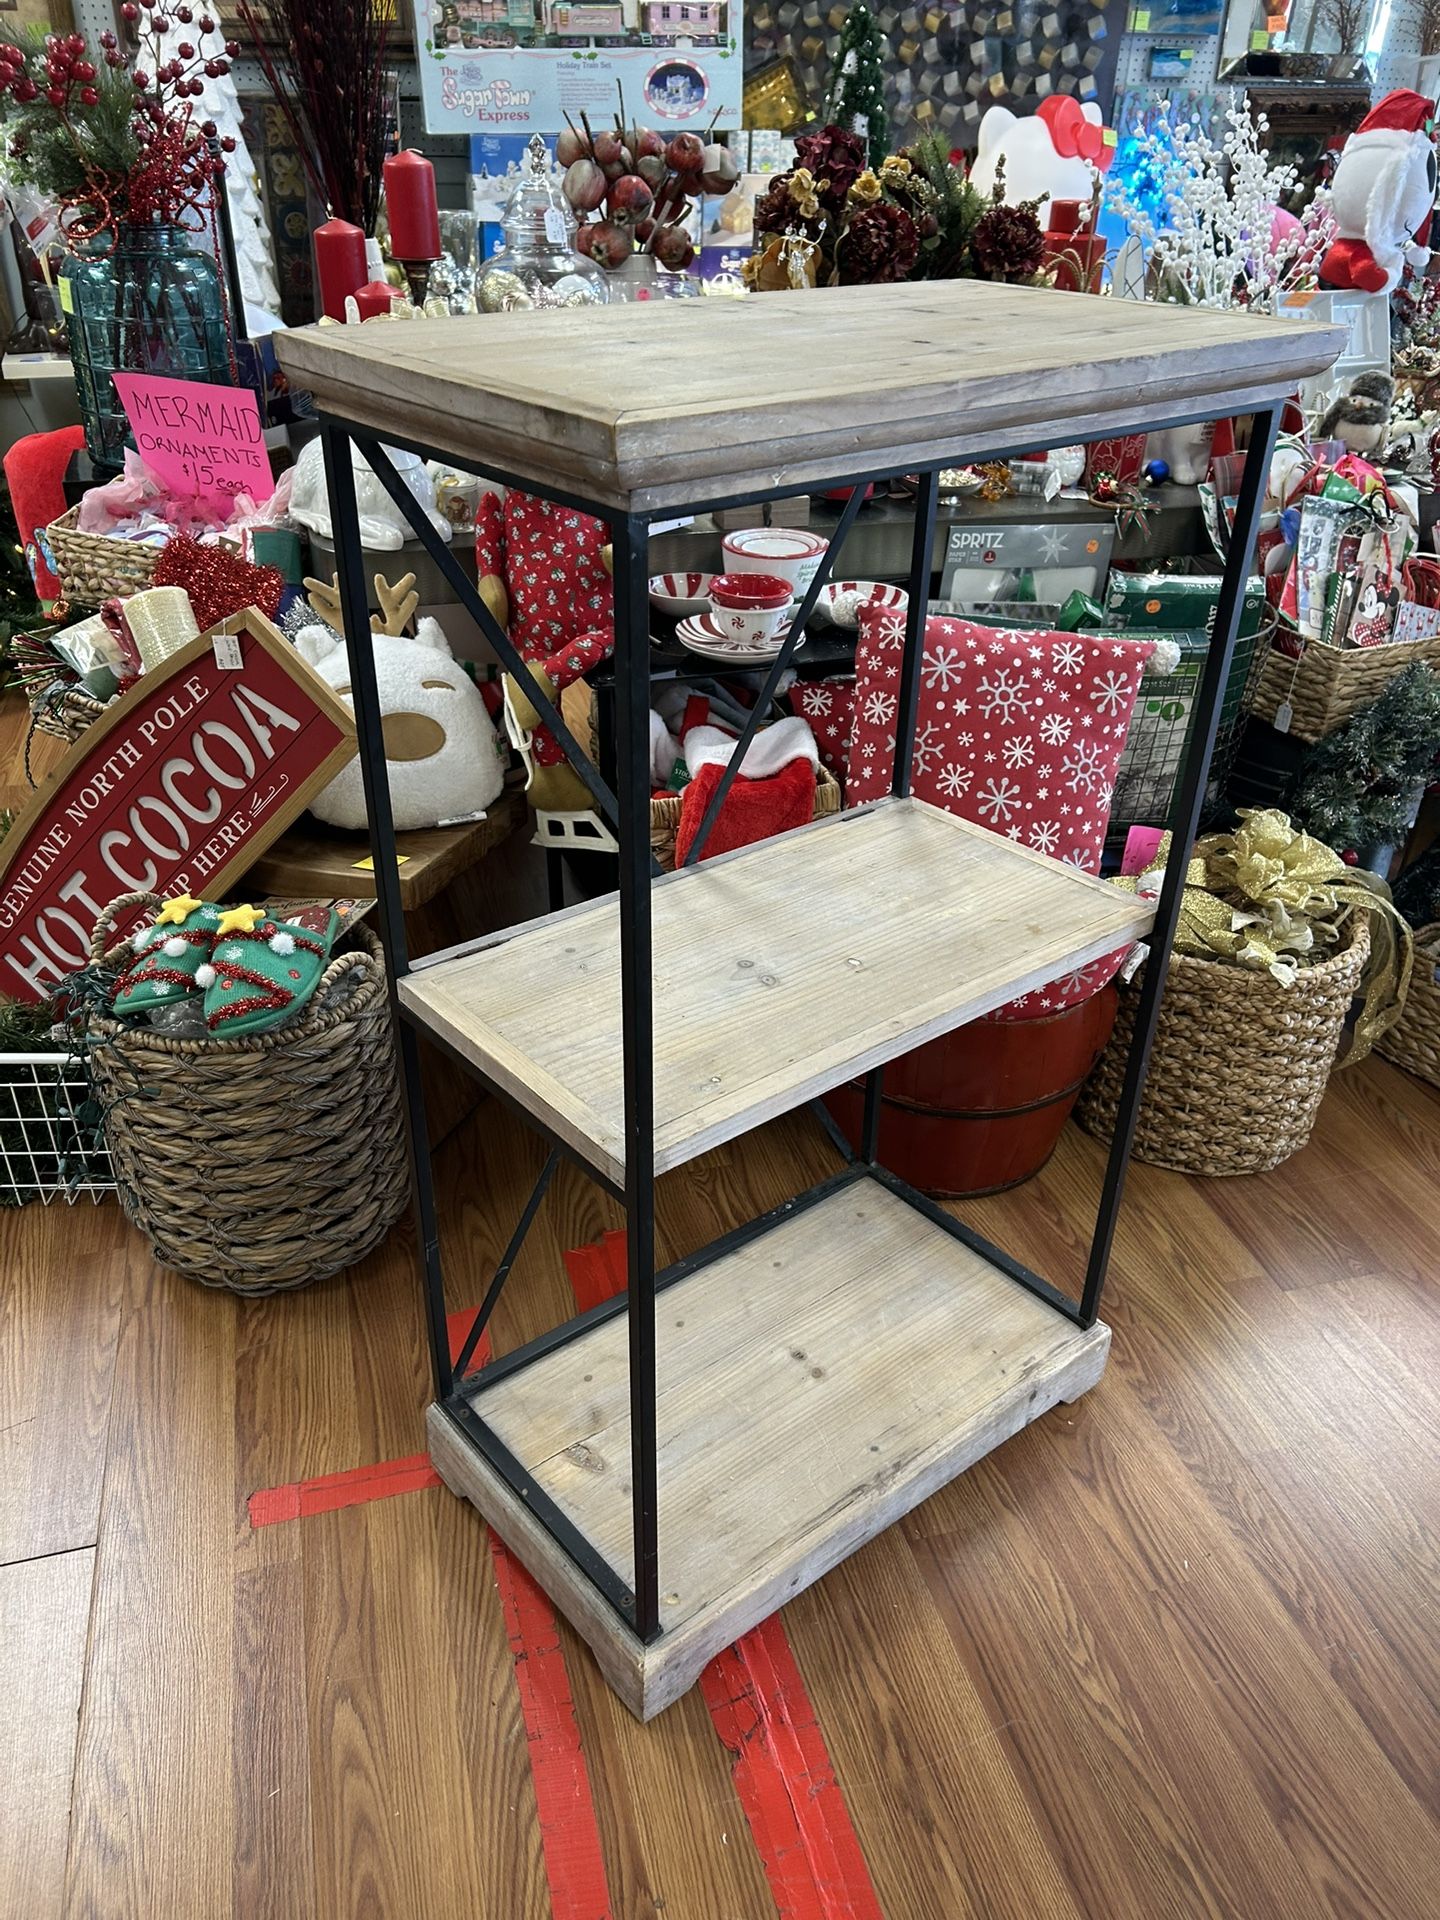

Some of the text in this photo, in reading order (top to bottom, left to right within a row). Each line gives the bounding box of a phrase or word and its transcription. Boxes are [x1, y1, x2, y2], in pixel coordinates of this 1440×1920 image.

[440, 66, 459, 76] The
[556, 61, 612, 70] Holiday Train Set
[442, 77, 493, 118] Sugar
[489, 79, 532, 110] Town
[478, 108, 530, 123] Express
[132, 391, 262, 443] MERMAID
[139, 433, 262, 468] ORNAMENTS
[183, 461, 253, 496] $15 each
[950, 533, 1004, 548] SPRITZ
[0, 674, 210, 930] GENUINE NORTH POLE
[4, 683, 301, 1001] HOT COCOA
[163, 872, 194, 911] UP
[191, 810, 253, 877] HERE
